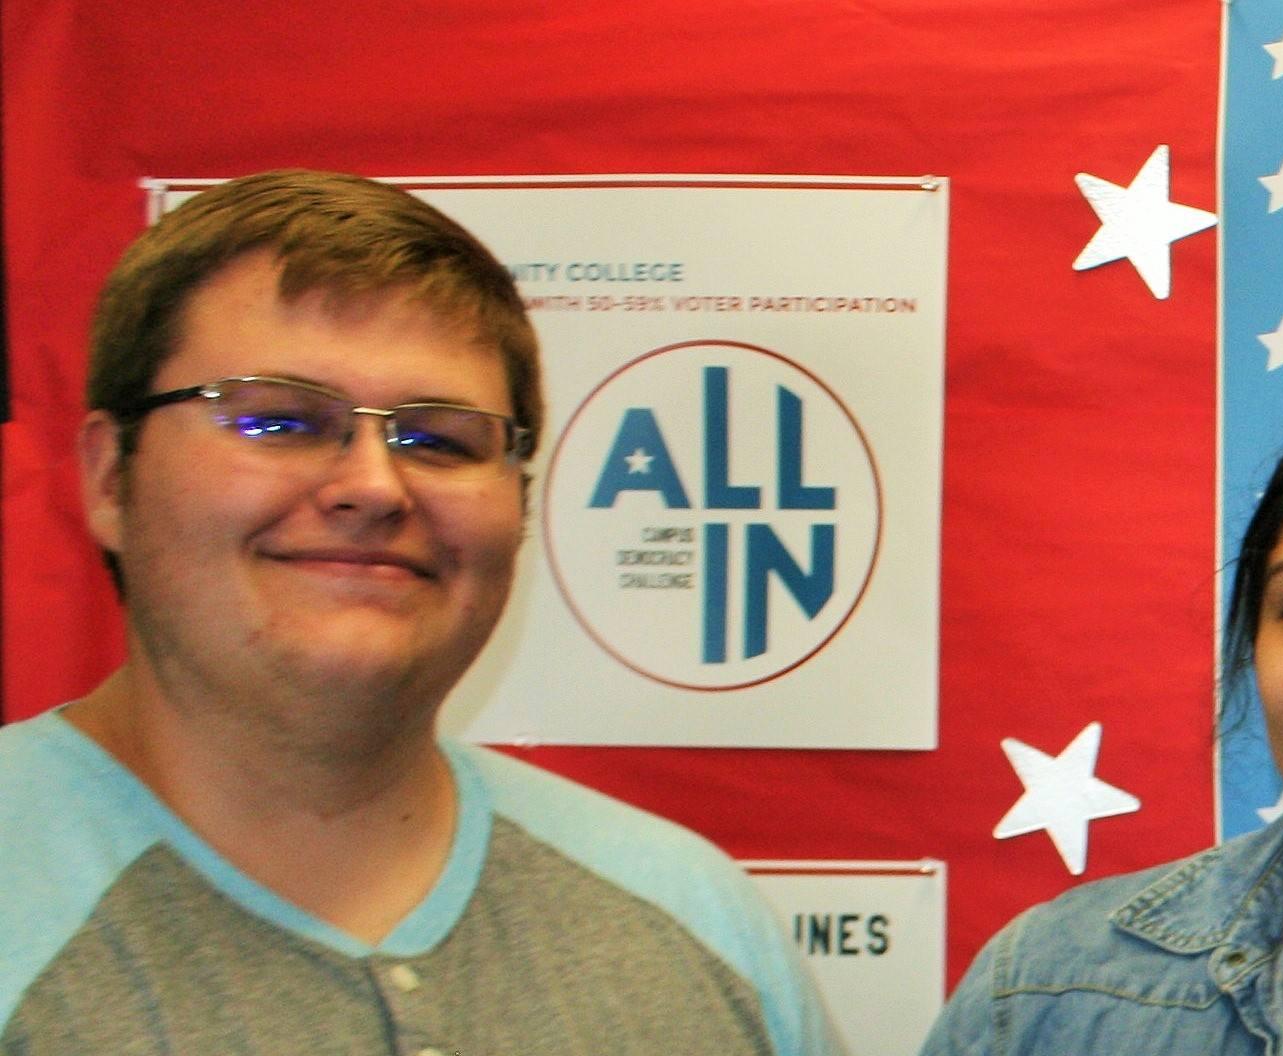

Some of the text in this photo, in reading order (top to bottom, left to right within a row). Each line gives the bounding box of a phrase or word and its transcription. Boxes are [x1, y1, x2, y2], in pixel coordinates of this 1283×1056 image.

[567, 263, 682, 282] COLLEGE
[672, 295, 742, 312] VOTER
[750, 297, 915, 313] PARTICIPATION
[587, 367, 836, 510] ALL
[703, 523, 836, 664] IN
